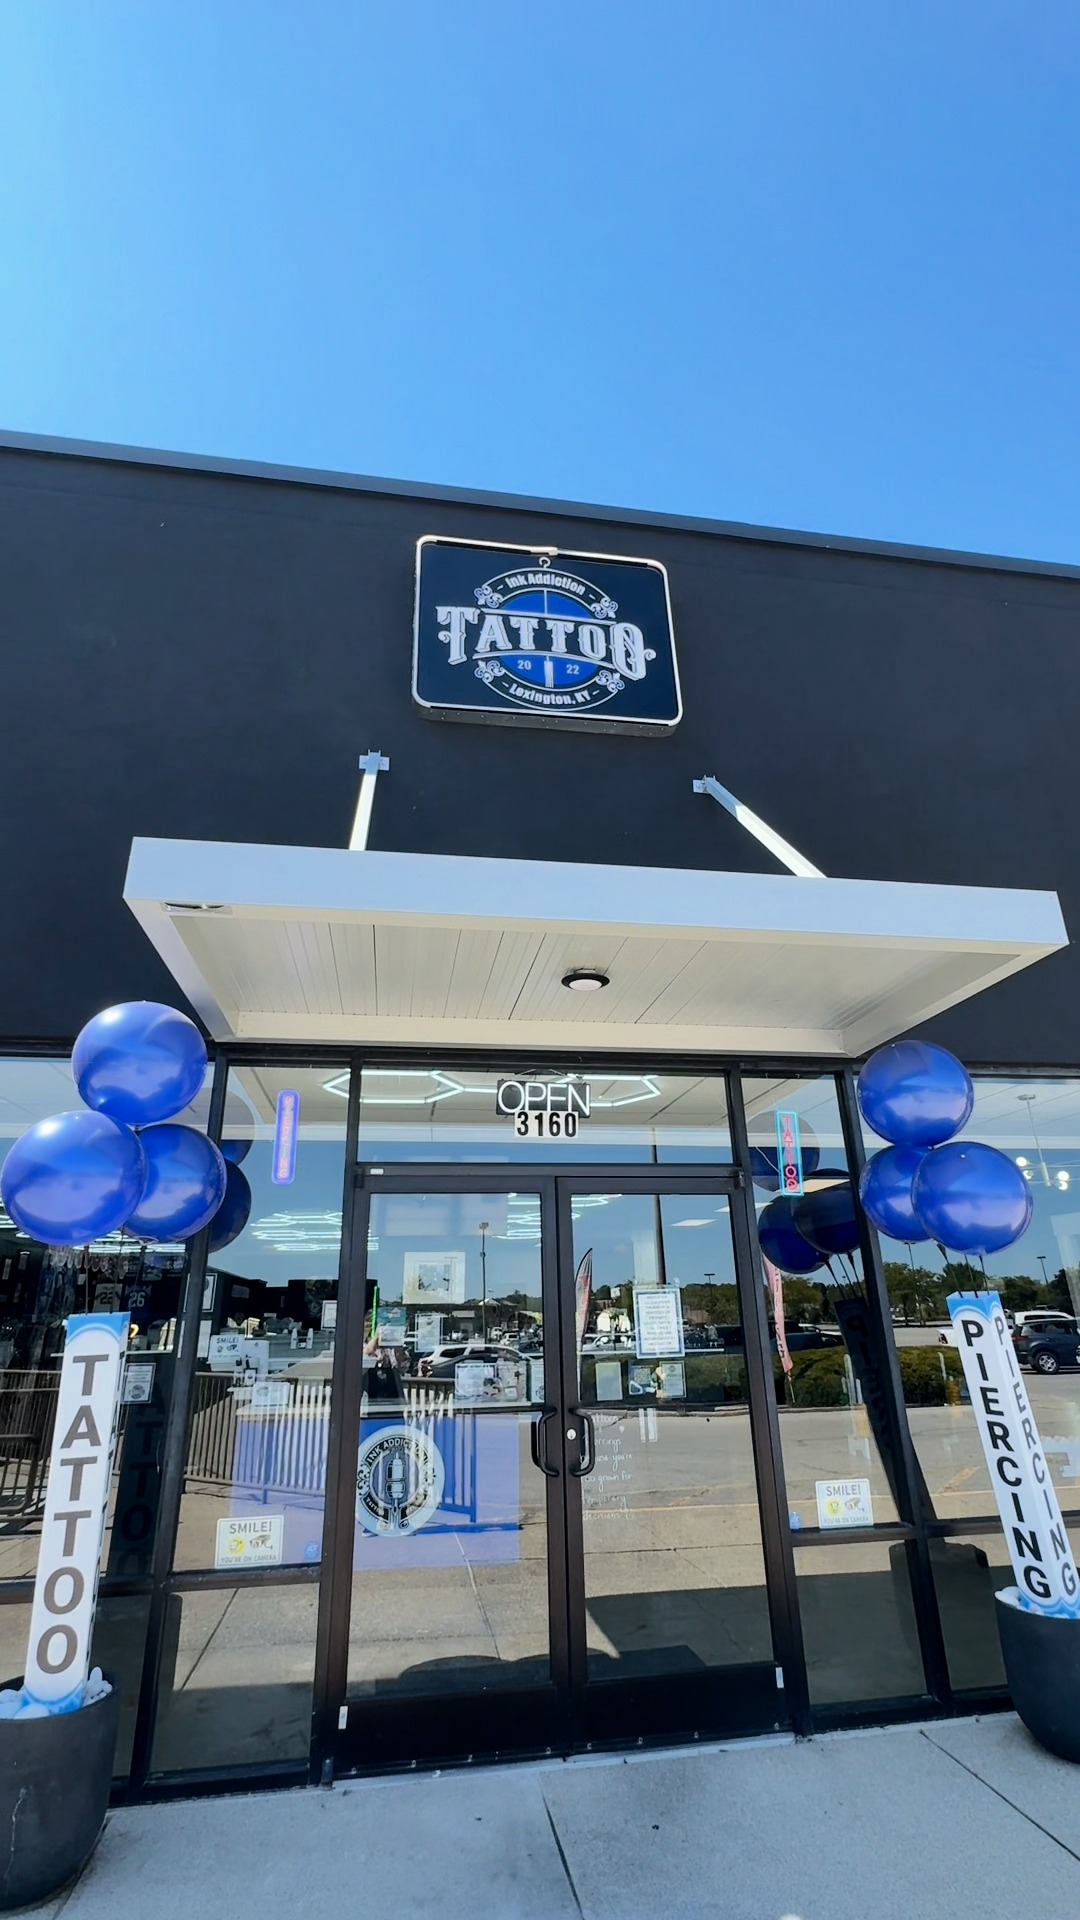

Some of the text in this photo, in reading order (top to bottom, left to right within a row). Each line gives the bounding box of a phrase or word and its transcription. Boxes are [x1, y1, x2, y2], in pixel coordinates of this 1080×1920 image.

[505, 573, 585, 595] Ink Addiction
[435, 606, 656, 681] TATTOO
[517, 660, 579, 675] 20 22
[575, 690, 591, 702] KY
[498, 1081, 590, 1116] OPEN
[517, 1111, 577, 1137] 3160
[366, 1448, 383, 1464] INK
[961, 1319, 1052, 1599] PIERCING
[994, 1315, 1077, 1597] PIERCING
[826, 1484, 861, 1497] SMILE!
[36, 1354, 109, 1675] TATTOO
[229, 1521, 272, 1534] SMILE!
